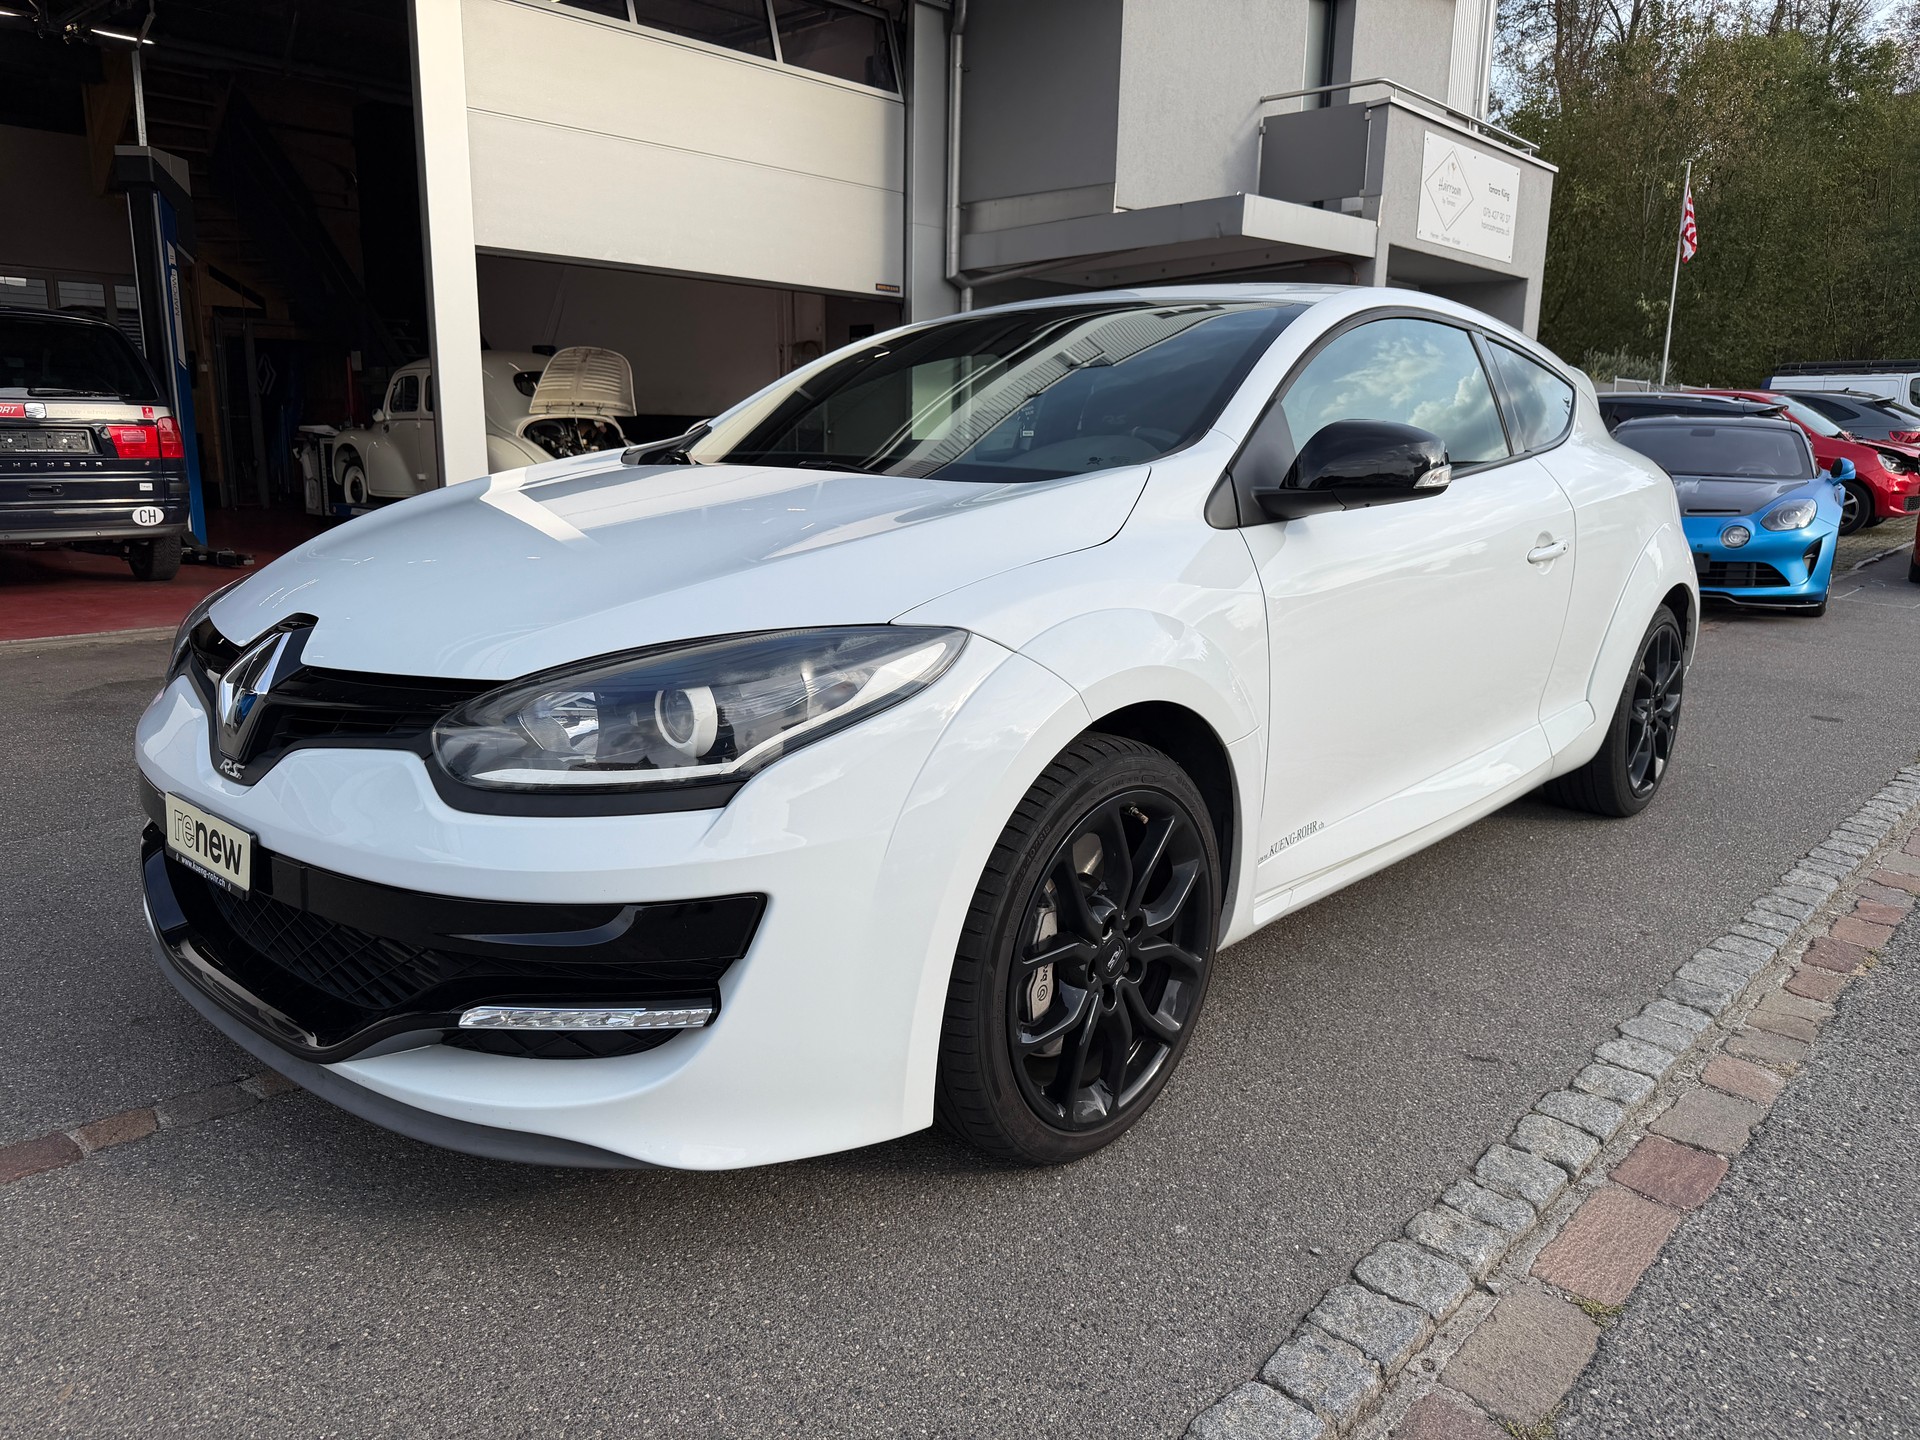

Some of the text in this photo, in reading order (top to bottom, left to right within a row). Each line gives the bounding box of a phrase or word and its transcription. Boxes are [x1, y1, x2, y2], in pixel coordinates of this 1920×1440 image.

[139, 509, 157, 524] CH
[174, 809, 242, 876] renew
[181, 856, 226, 887] www.kueng-rohr.ch
